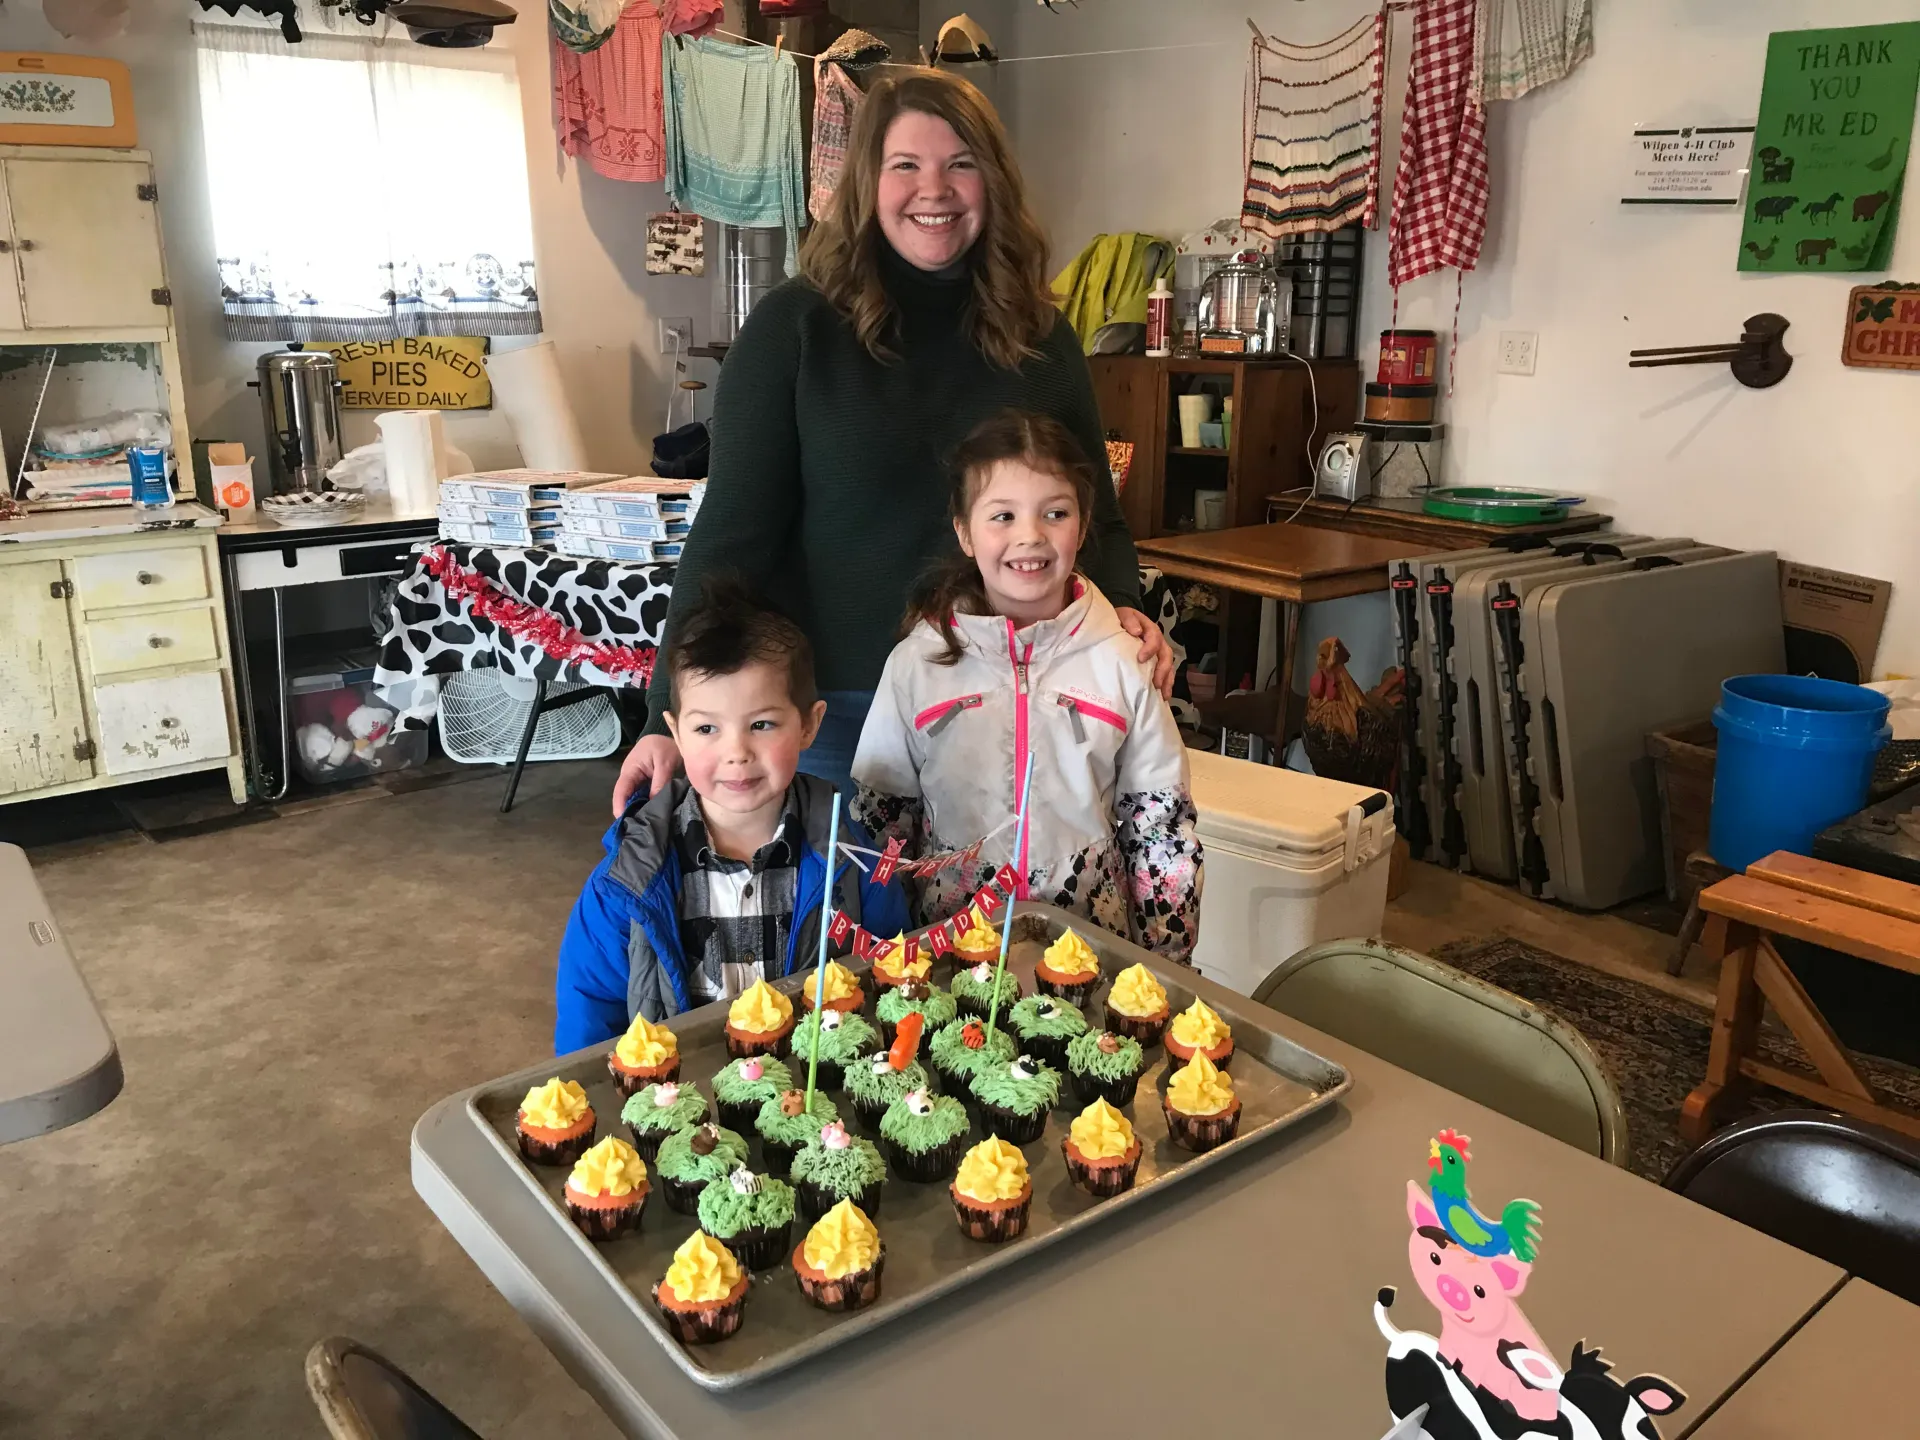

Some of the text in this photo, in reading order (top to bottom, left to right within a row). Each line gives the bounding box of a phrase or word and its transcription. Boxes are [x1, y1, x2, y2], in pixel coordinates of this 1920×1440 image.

[1797, 40, 1892, 71] THANK
[1810, 76, 1861, 101] YOU
[1782, 111, 1878, 137] MR ED
[1643, 140, 1735, 152] Wilpen 4-H Club
[1652, 152, 1719, 162] Meets Here!
[330, 338, 481, 379] RESH BAKED
[372, 361, 428, 387] PIES
[417, 391, 468, 406] DAILY
[1069, 686, 1113, 706] SPYDER
[835, 868, 1014, 960] BIRTHDAY
